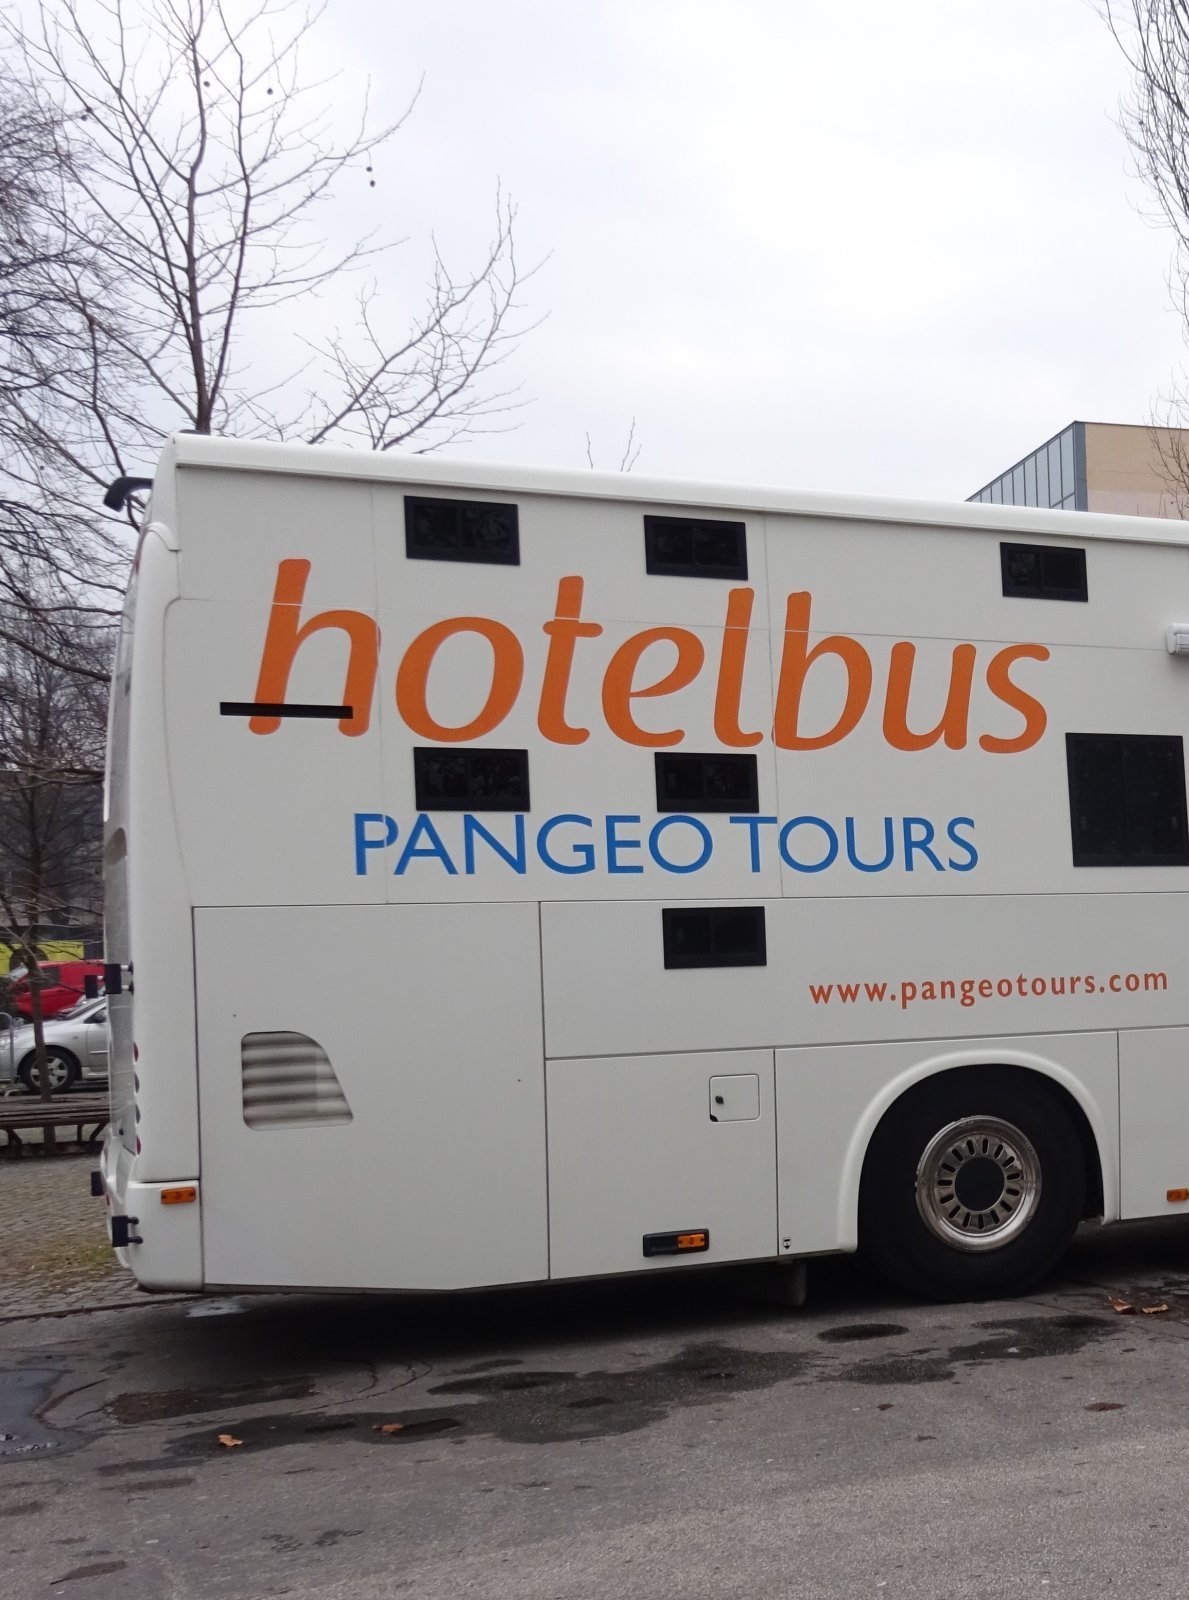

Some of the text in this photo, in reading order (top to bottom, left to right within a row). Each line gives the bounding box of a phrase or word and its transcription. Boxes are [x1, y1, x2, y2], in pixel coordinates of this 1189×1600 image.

[248, 558, 1050, 754] hotelbus
[353, 813, 979, 876] PANGEO TOURS
[808, 970, 1169, 1009] www.pangeotours.com
